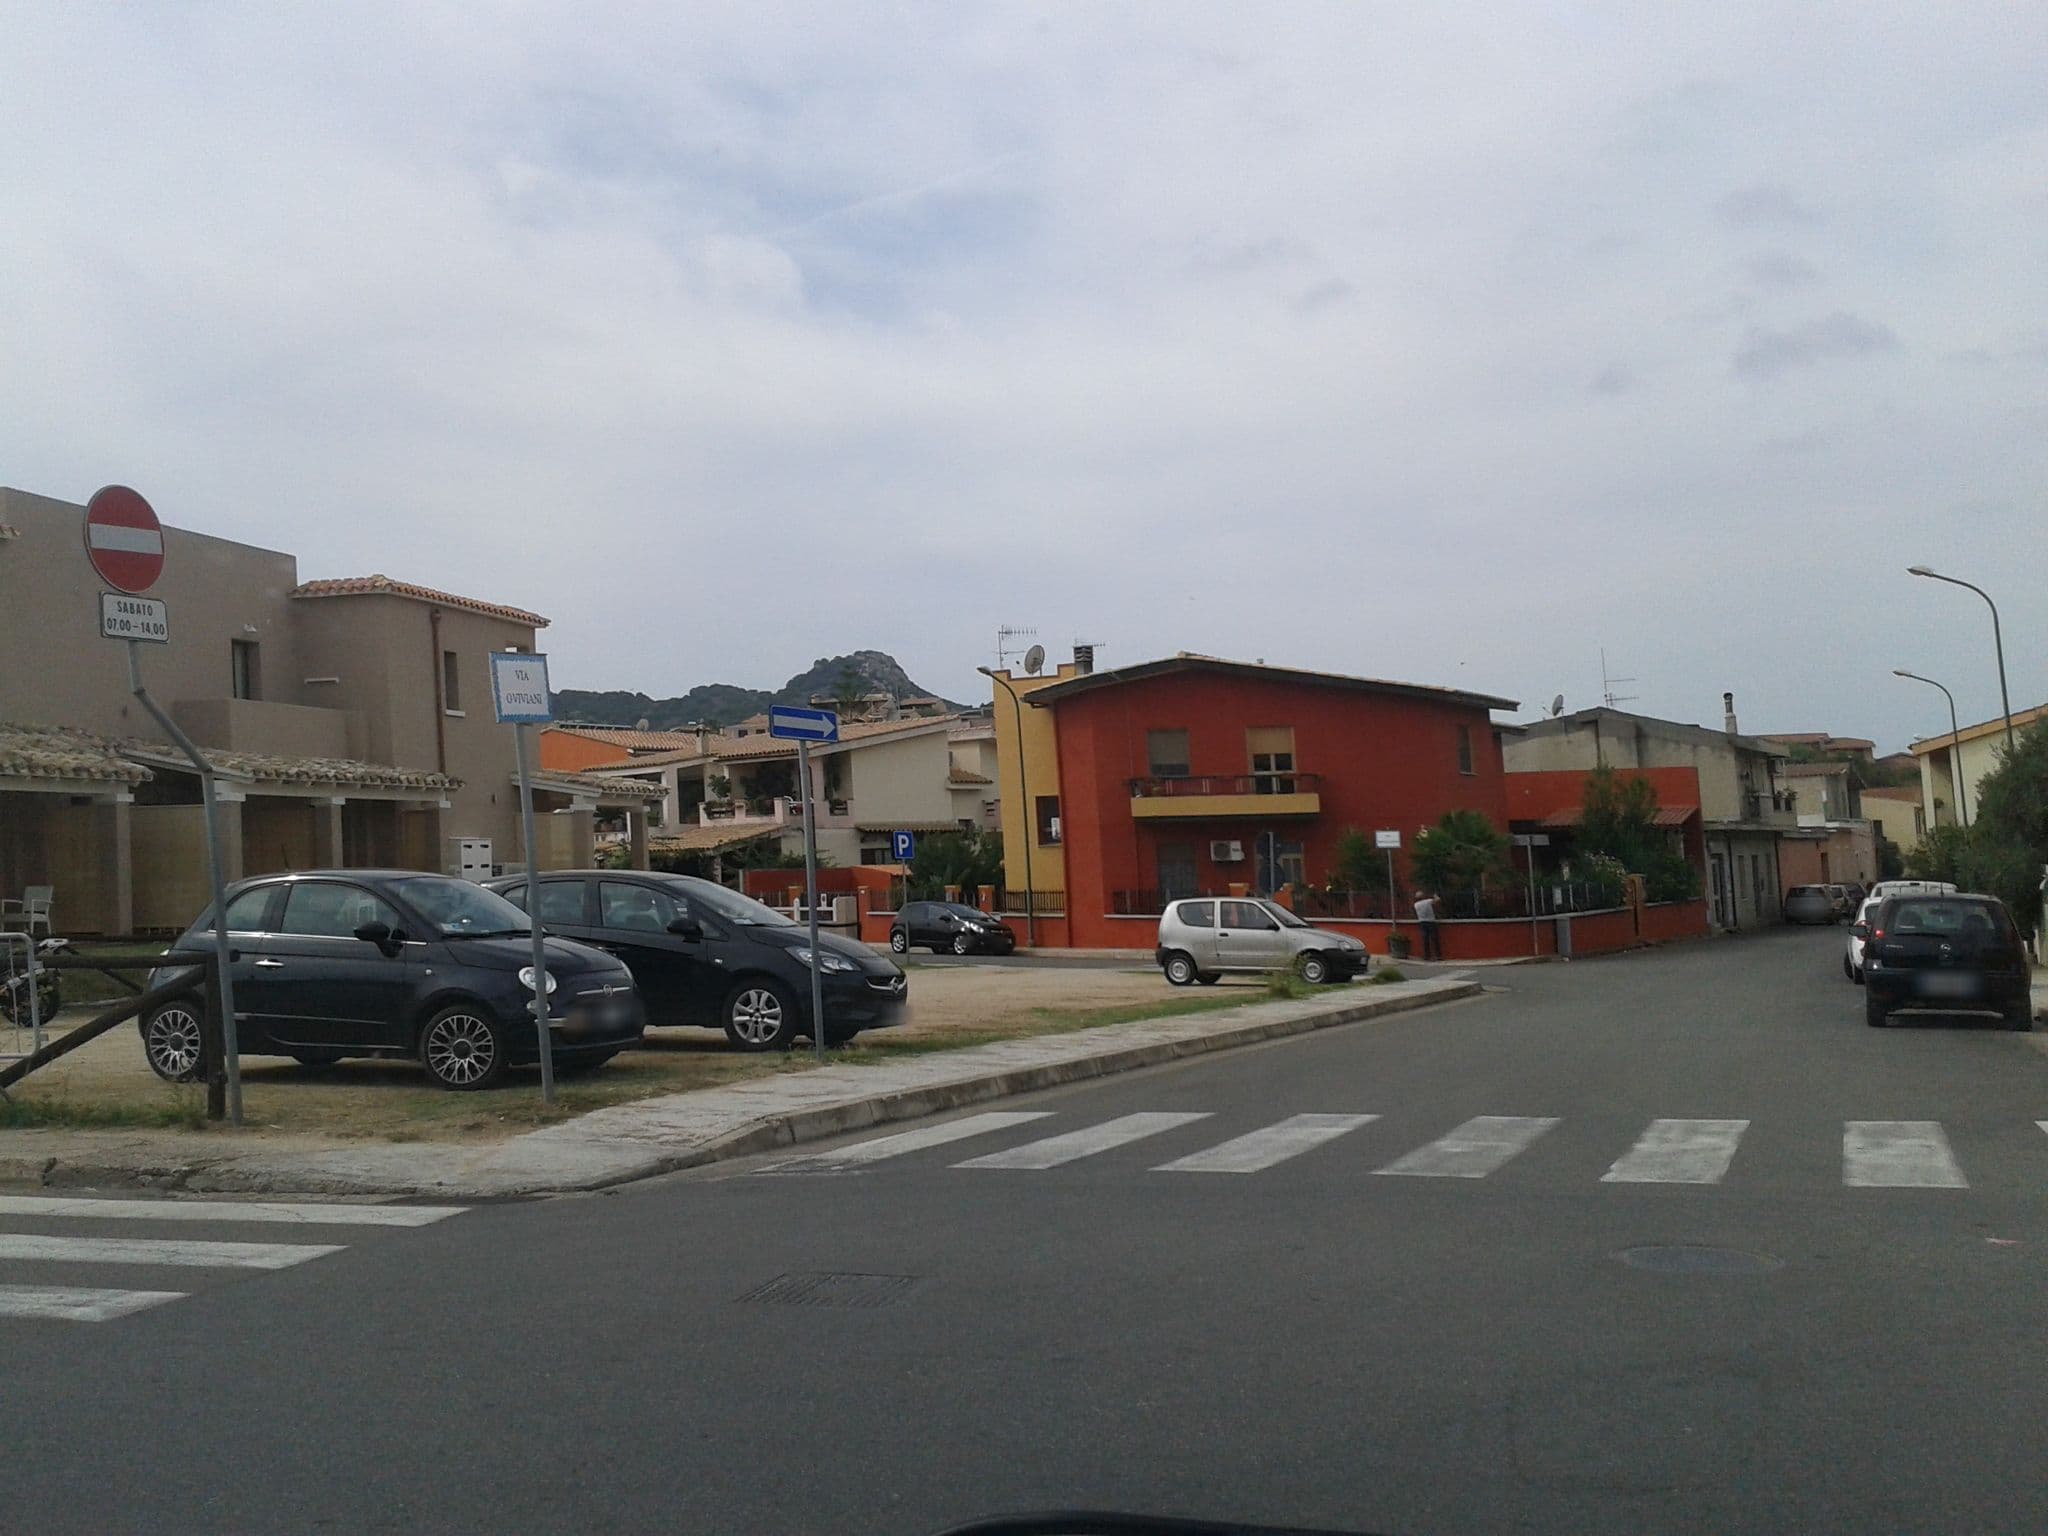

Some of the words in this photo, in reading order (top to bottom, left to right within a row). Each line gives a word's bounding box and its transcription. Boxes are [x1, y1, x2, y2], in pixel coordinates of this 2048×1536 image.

[117, 601, 153, 616] SABATO
[515, 670, 529, 681] VIA
[898, 834, 909, 855] P
